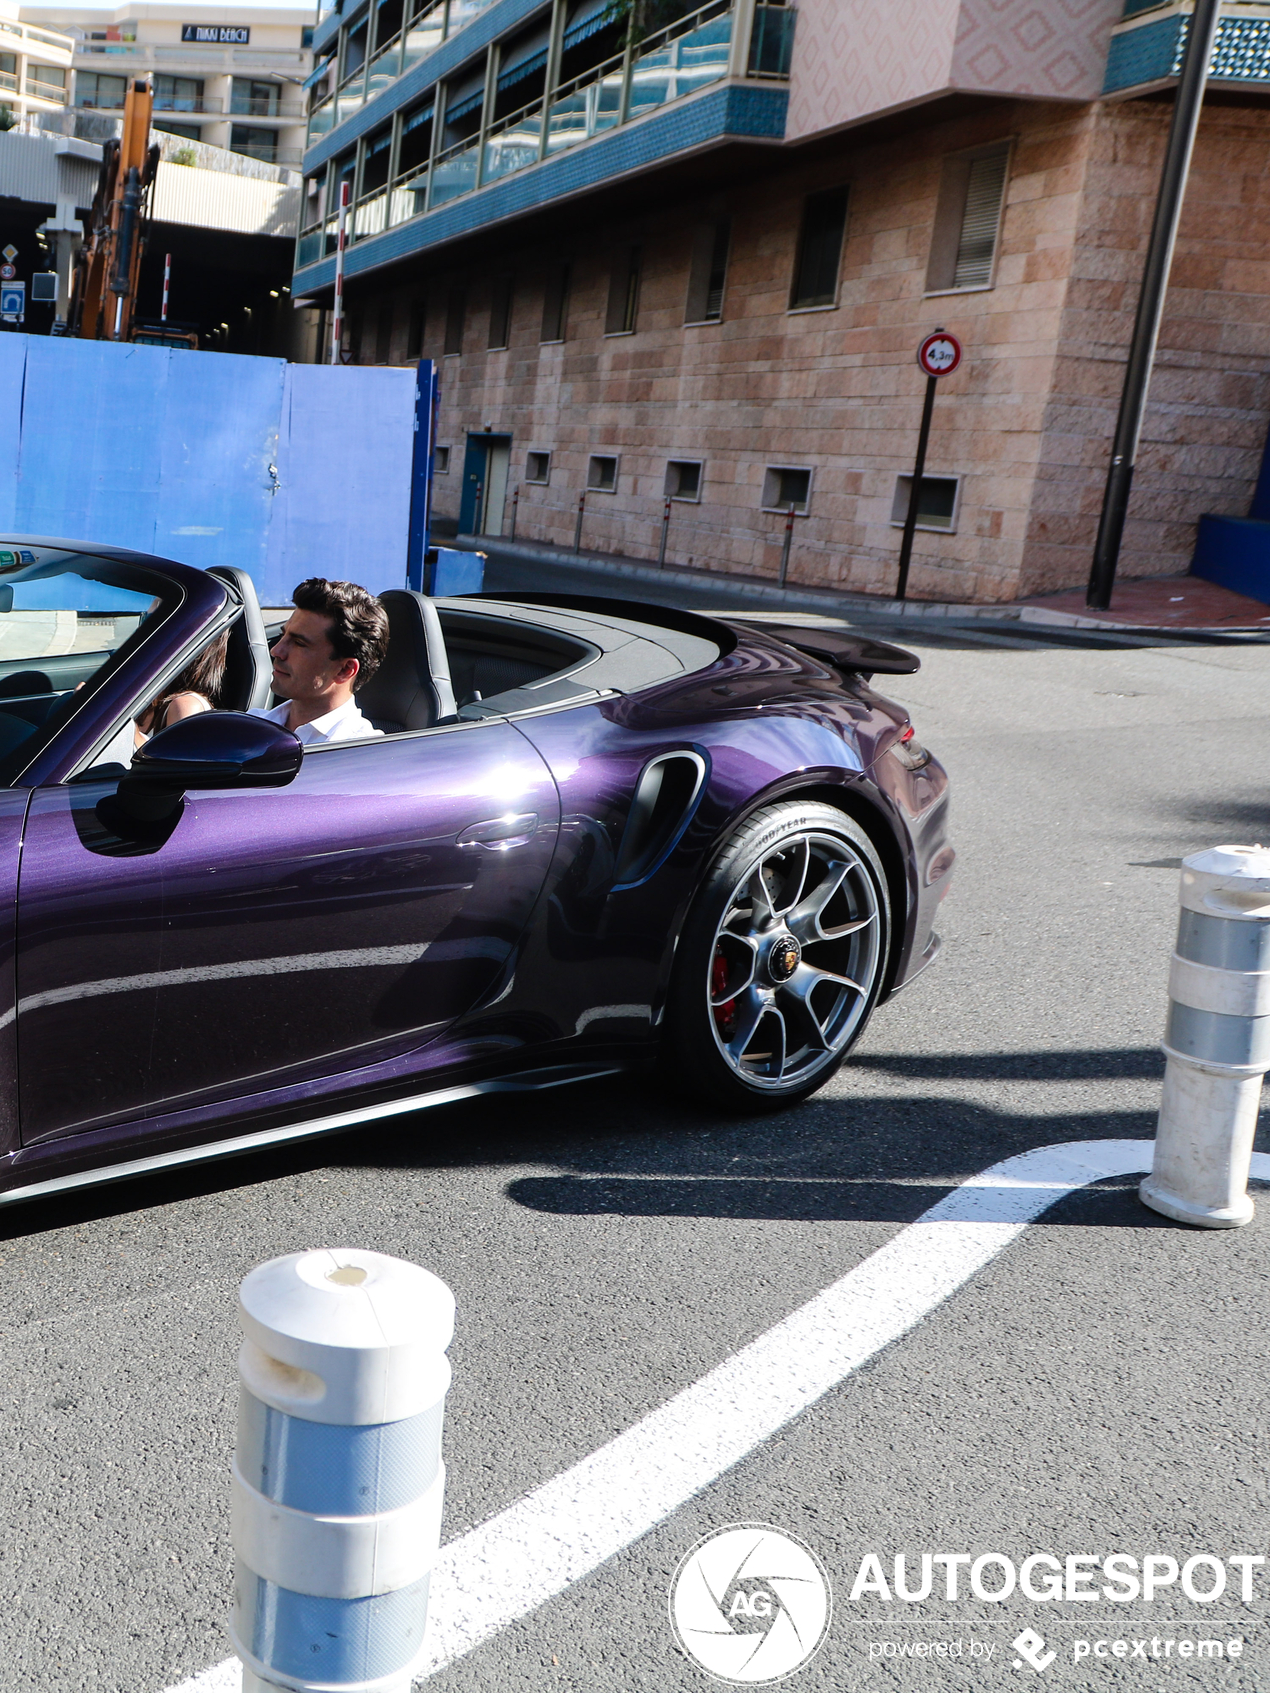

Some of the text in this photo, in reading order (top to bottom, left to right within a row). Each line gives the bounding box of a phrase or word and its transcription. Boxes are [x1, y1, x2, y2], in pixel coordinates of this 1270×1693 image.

[196, 26, 248, 43] NIKKI BEACH
[2, 267, 12, 275] 50
[927, 348, 954, 362] 4,3m
